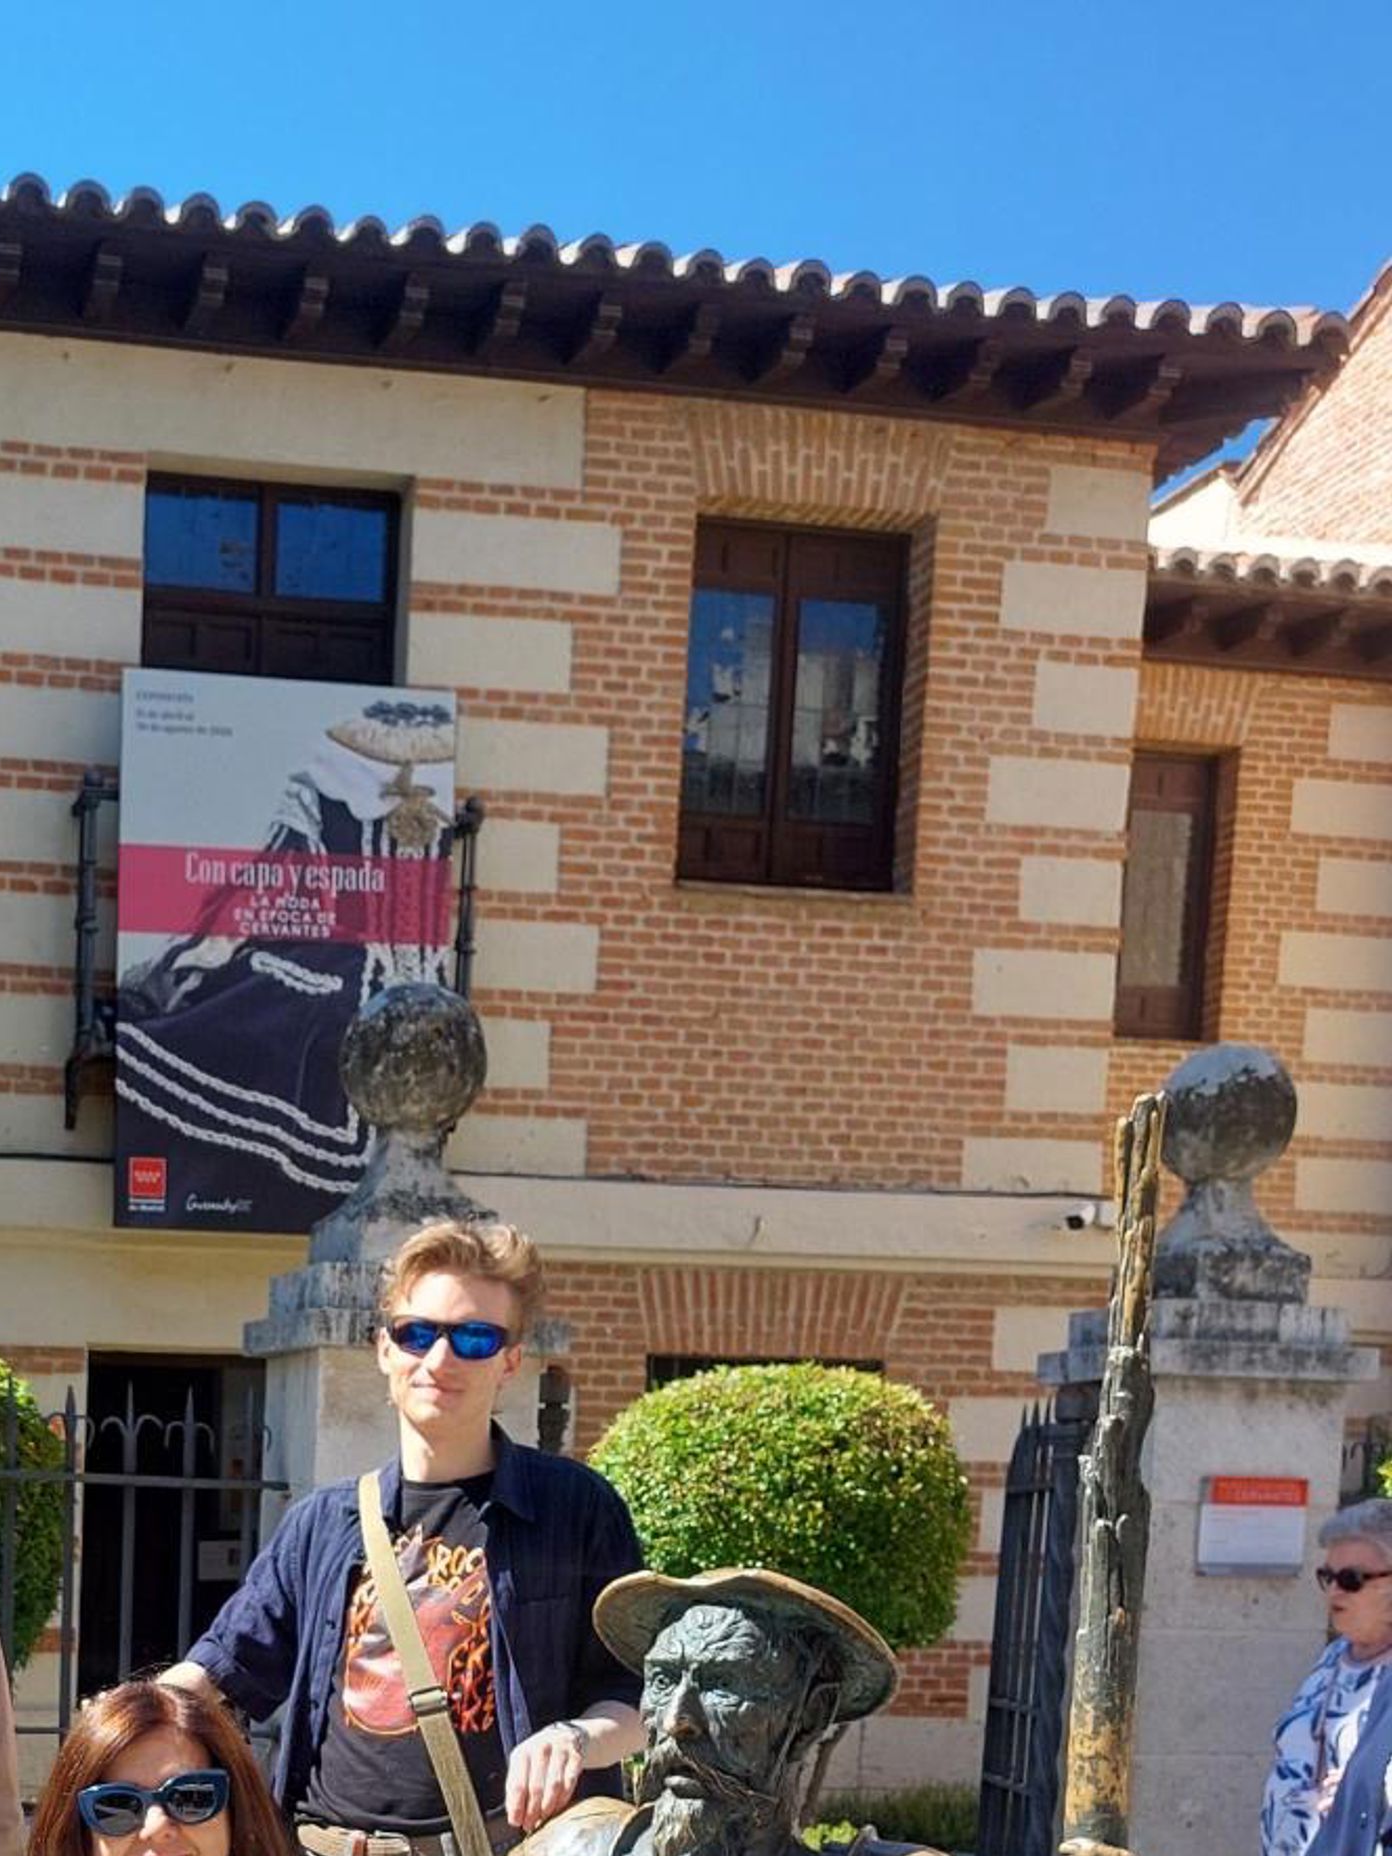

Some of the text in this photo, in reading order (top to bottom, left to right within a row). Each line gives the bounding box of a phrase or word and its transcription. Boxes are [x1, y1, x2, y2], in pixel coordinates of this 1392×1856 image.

[185, 852, 385, 899] Con capa y espada
[250, 896, 321, 910] LA MODA
[234, 908, 255, 922] EN
[317, 912, 336, 927] DE
[239, 921, 331, 938] CERVANTES
